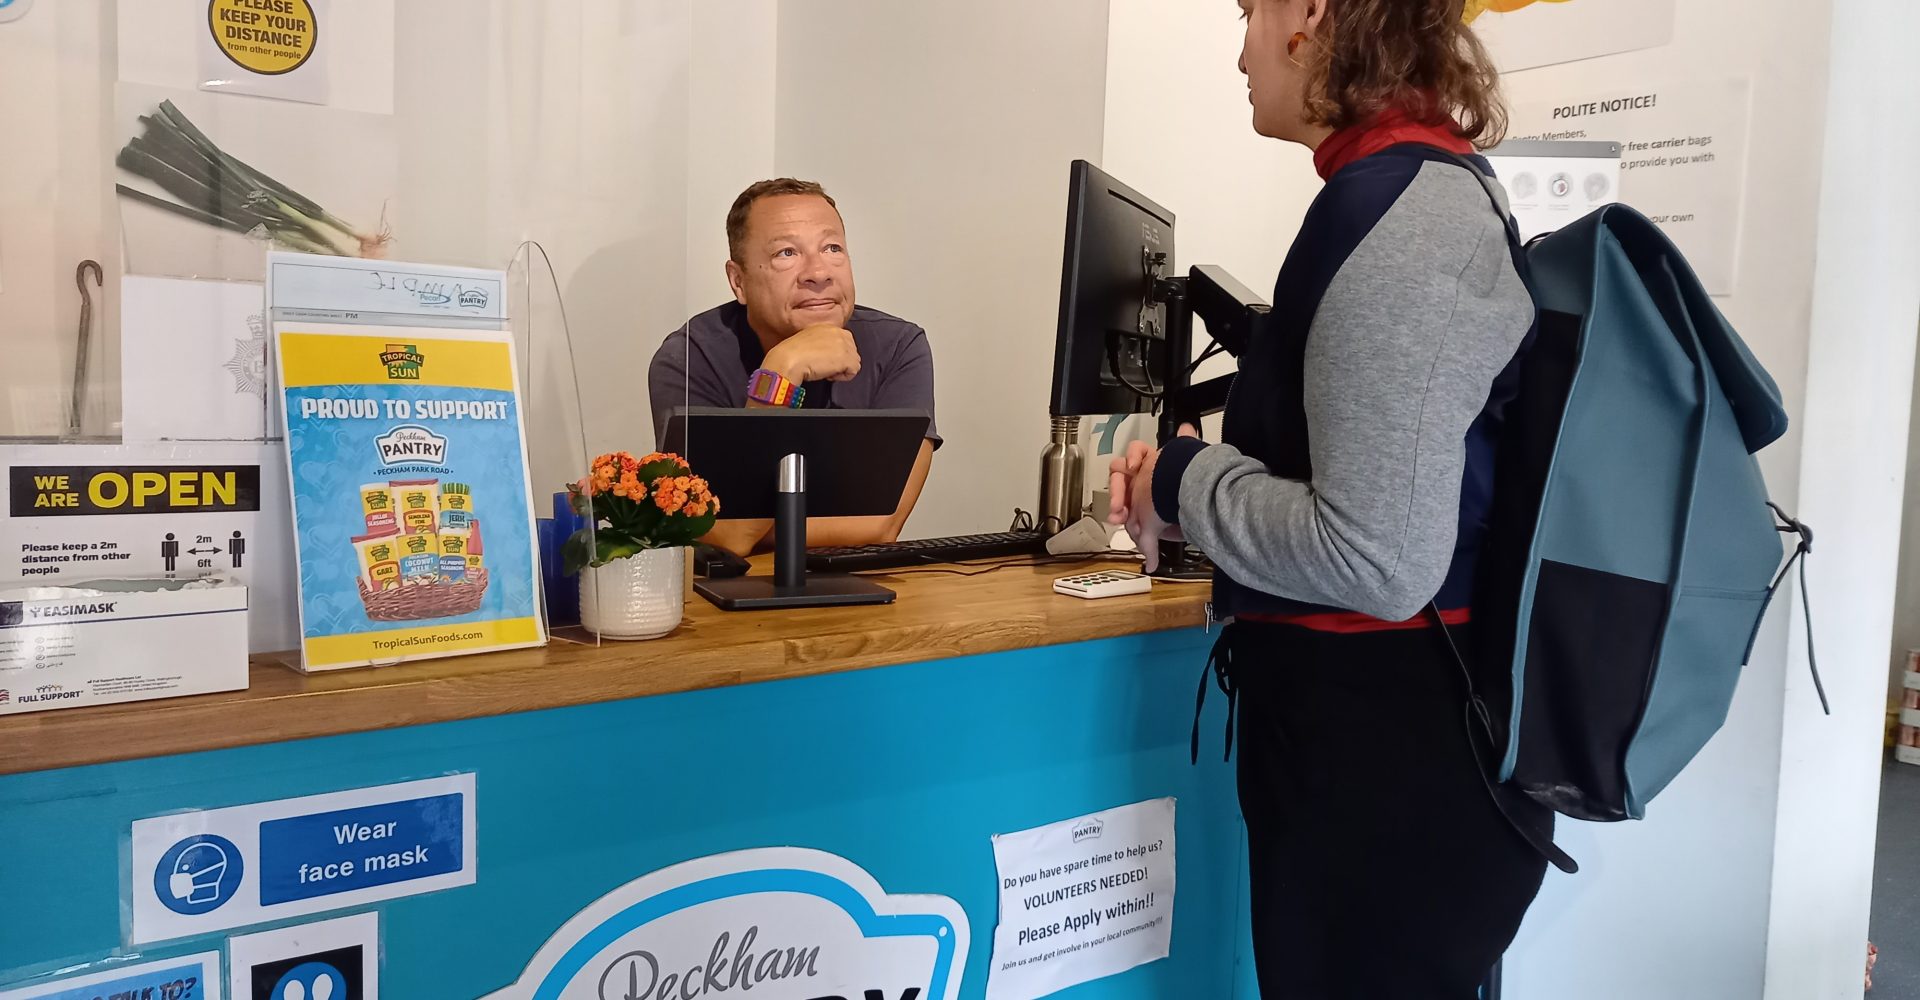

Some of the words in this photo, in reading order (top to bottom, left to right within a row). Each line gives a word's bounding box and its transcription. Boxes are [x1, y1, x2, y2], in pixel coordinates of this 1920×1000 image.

[220, 8, 261, 25] KEEP
[265, 14, 306, 32] YOUR
[226, 25, 302, 48] DISTANCE
[228, 42, 248, 52] from
[250, 45, 272, 55] other
[274, 49, 302, 59] people
[1553, 102, 1597, 119] POLITE
[1600, 94, 1657, 113] NOTICE!
[1542, 128, 1587, 141] Members,
[1628, 141, 1648, 150] free
[1651, 139, 1685, 149] carrier
[1688, 134, 1712, 146] bags
[1629, 157, 1667, 170] provide
[1670, 156, 1688, 166] you
[1691, 152, 1715, 162] with
[1650, 215, 1669, 224] our
[1672, 213, 1694, 222] own
[460, 297, 485, 305] PANTRY
[382, 353, 422, 363] TROPICAL
[390, 368, 417, 378] SUN
[302, 398, 379, 419] PROUD
[383, 399, 411, 420] TO
[415, 400, 508, 420] SUPPORT
[395, 431, 426, 442] Peckham
[383, 443, 442, 457] PANTRY
[378, 466, 411, 476] PECKHAM
[412, 466, 430, 474] PARK
[431, 467, 449, 475] ROAD
[34, 475, 70, 490] WE
[88, 471, 236, 508] OPEN
[34, 492, 79, 508] ARE
[196, 535, 212, 543] 2m
[22, 542, 59, 552] Please
[62, 542, 88, 553] keep
[22, 554, 70, 564] distance
[72, 553, 105, 561] from
[105, 552, 130, 560] other
[197, 558, 212, 568] 6ft
[405, 557, 433, 567] COCONUT
[22, 566, 60, 576] people
[373, 630, 483, 650] TropicalSunFoods.com
[18, 695, 39, 704] FULL
[41, 691, 81, 701] SUPPORT
[334, 818, 397, 844] Wear
[1074, 825, 1101, 839] PANTRY
[299, 859, 354, 885] face
[364, 846, 429, 871] mask
[1004, 878, 1016, 889] Do
[1019, 873, 1037, 887] you
[1039, 865, 1062, 880] have
[1063, 860, 1089, 878] spare
[1091, 852, 1112, 867] time
[1114, 850, 1124, 860] to
[1126, 844, 1146, 858] help
[1148, 839, 1163, 852] us?
[1024, 880, 1097, 910] VOLUNTEERS
[1100, 867, 1149, 890] NEEDED!
[1018, 922, 1060, 945] Please
[1064, 909, 1101, 932] Apply
[1106, 892, 1154, 920] within!!
[1002, 960, 1016, 971] Join
[1028, 954, 1042, 963] and
[1043, 951, 1055, 962] get
[1056, 945, 1081, 957] involve
[1090, 937, 1106, 948] your
[1106, 931, 1122, 942] local
[598, 926, 820, 1000] Peckham
[108, 986, 154, 1000] LK
[160, 977, 197, 1000] TO?
